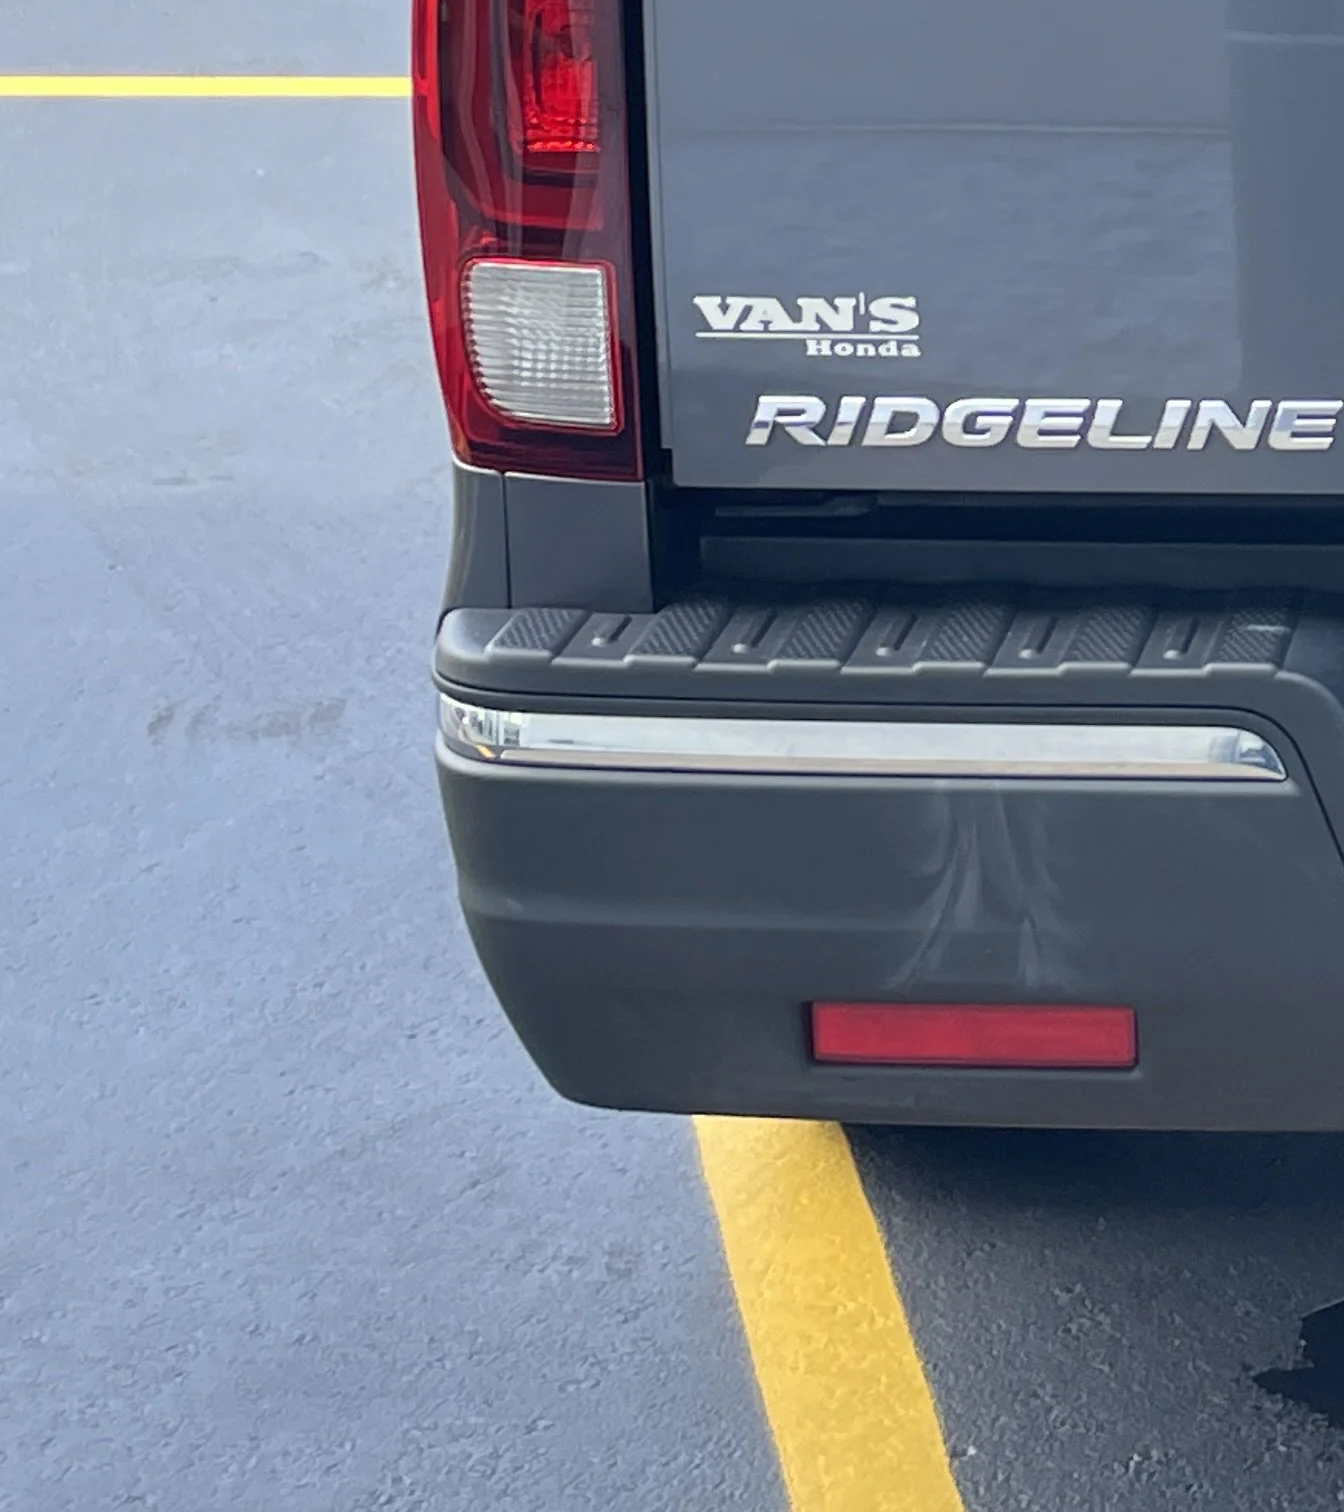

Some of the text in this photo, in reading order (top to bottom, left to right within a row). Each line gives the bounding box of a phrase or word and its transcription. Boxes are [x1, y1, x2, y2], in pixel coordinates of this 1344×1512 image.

[693, 291, 920, 333] VAN'S
[805, 338, 921, 357] Honda
[744, 395, 1344, 451] RIDGELINE
